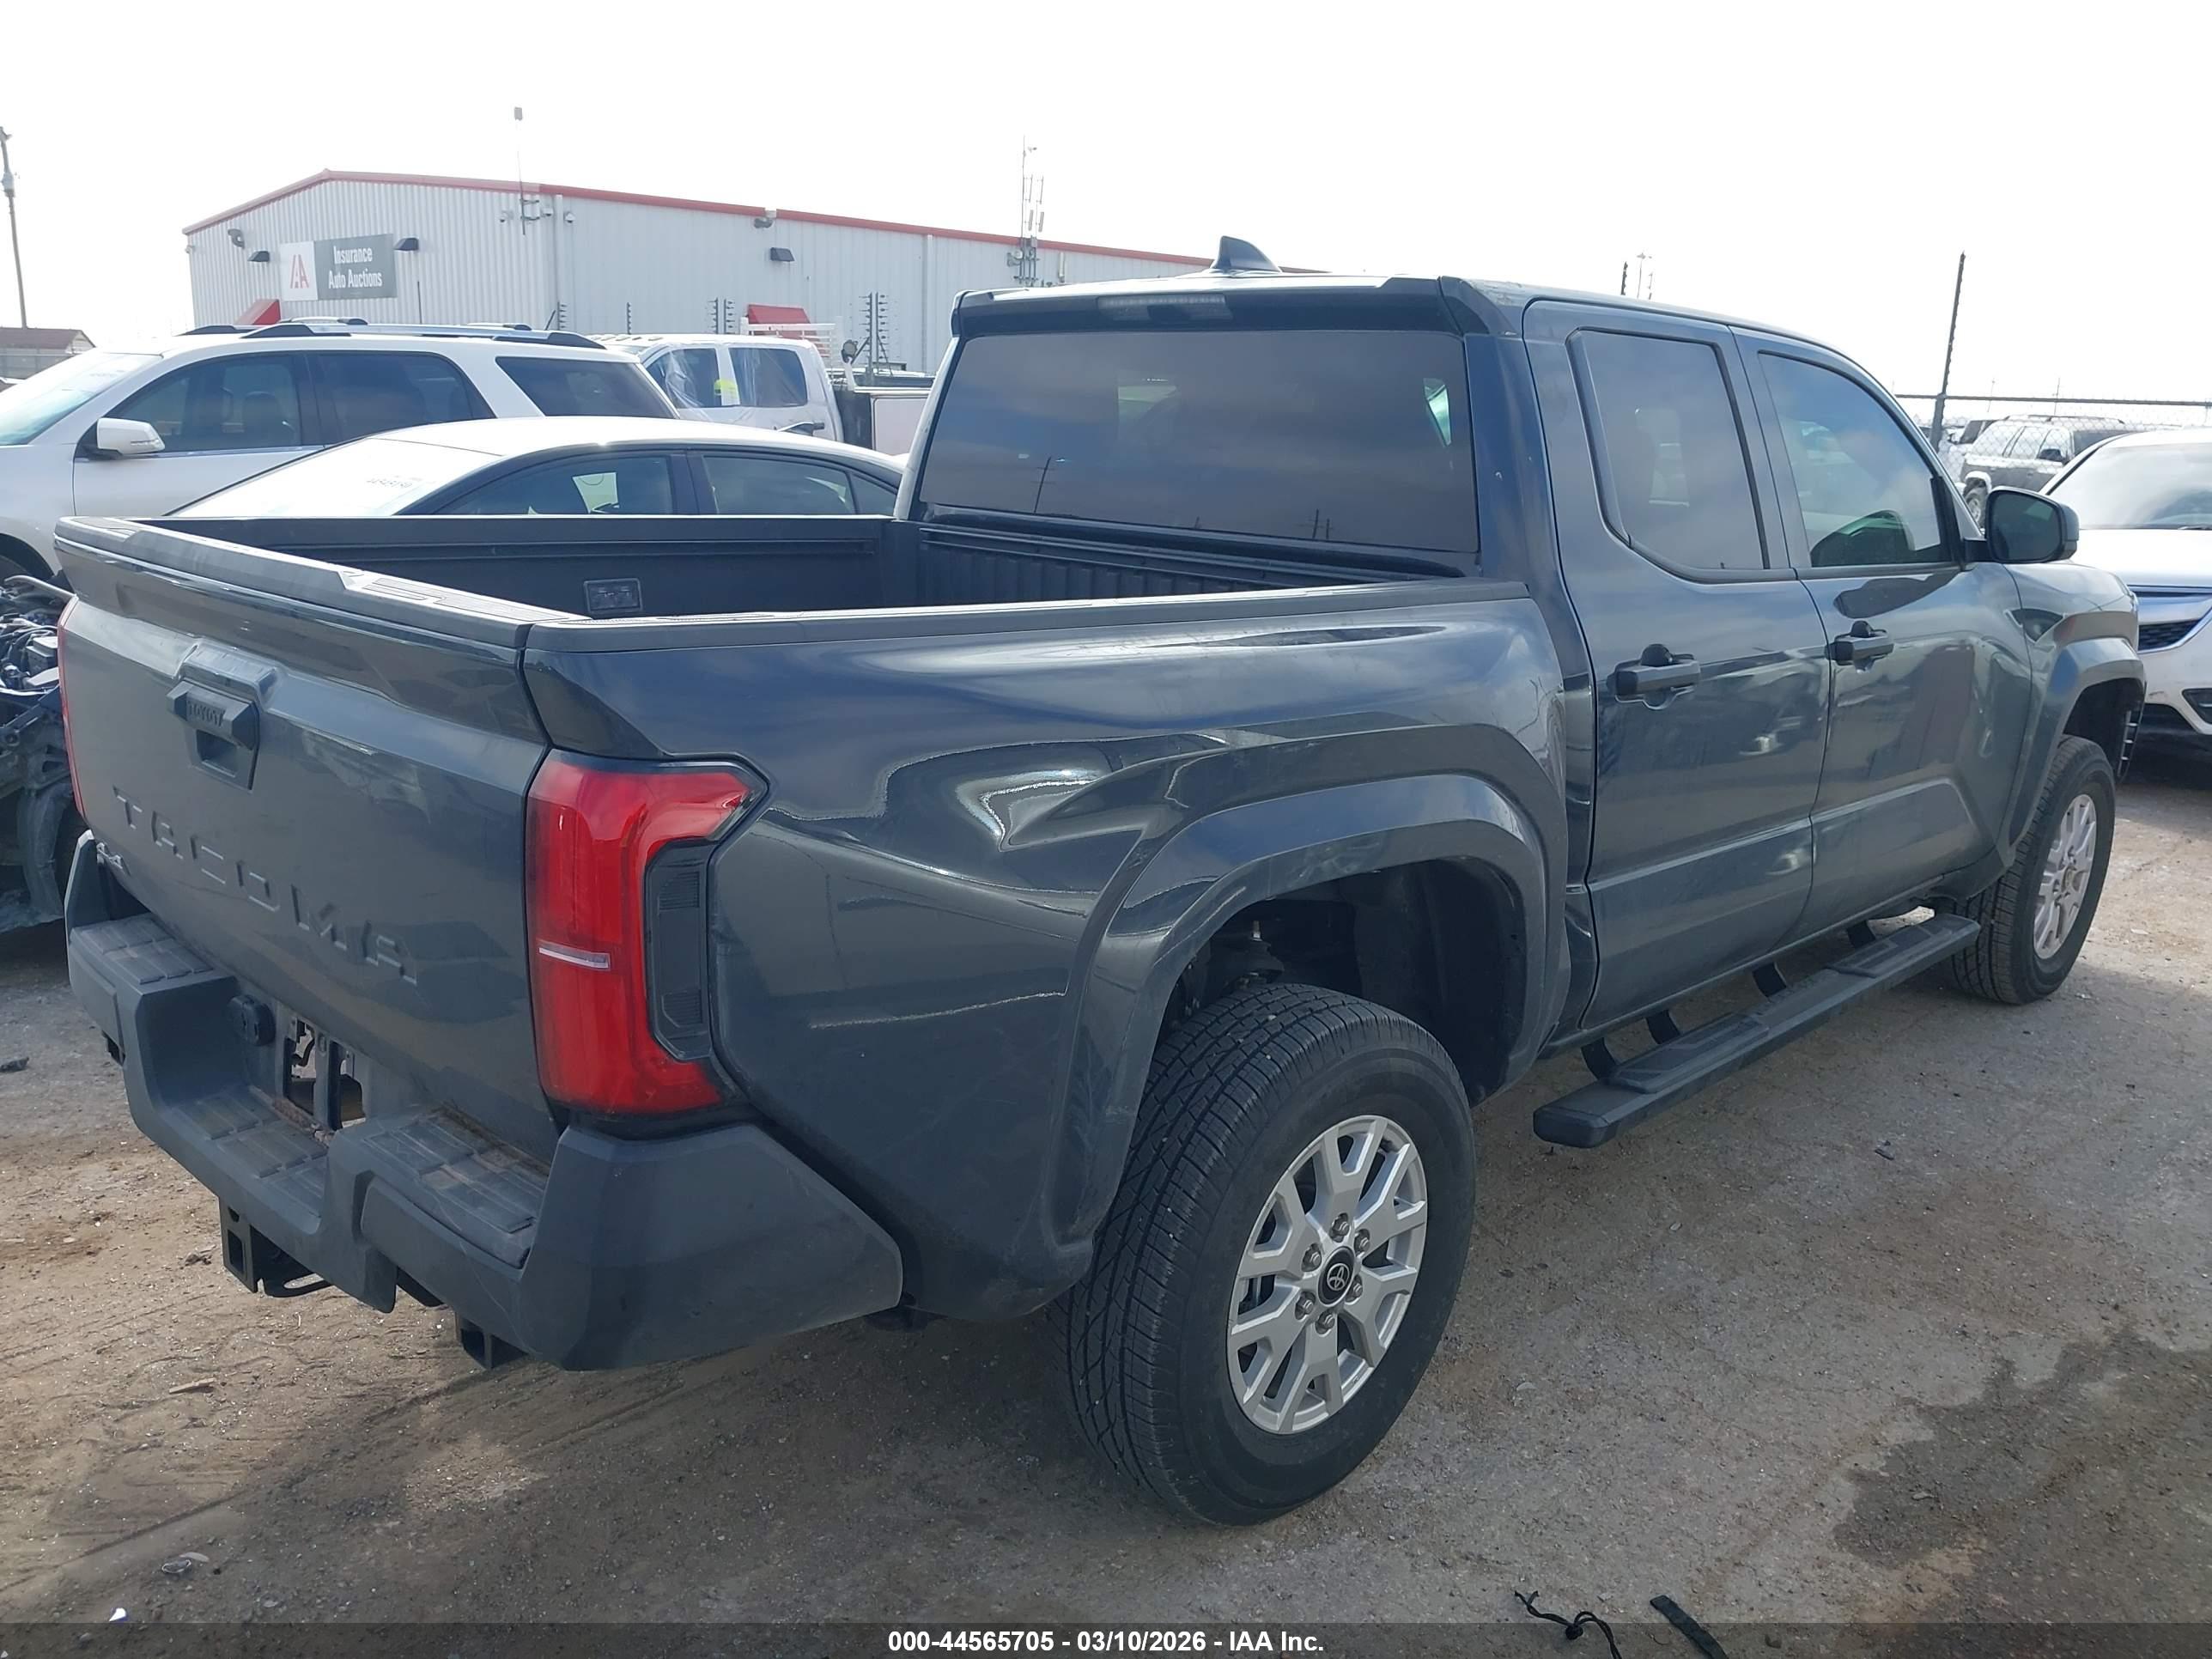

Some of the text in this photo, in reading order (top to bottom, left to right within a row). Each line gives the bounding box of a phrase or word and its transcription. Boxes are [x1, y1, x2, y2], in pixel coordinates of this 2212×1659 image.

[333, 245, 373, 264] Insurance
[328, 268, 383, 289] Auto Auctions
[112, 785, 417, 986] TACOMA
